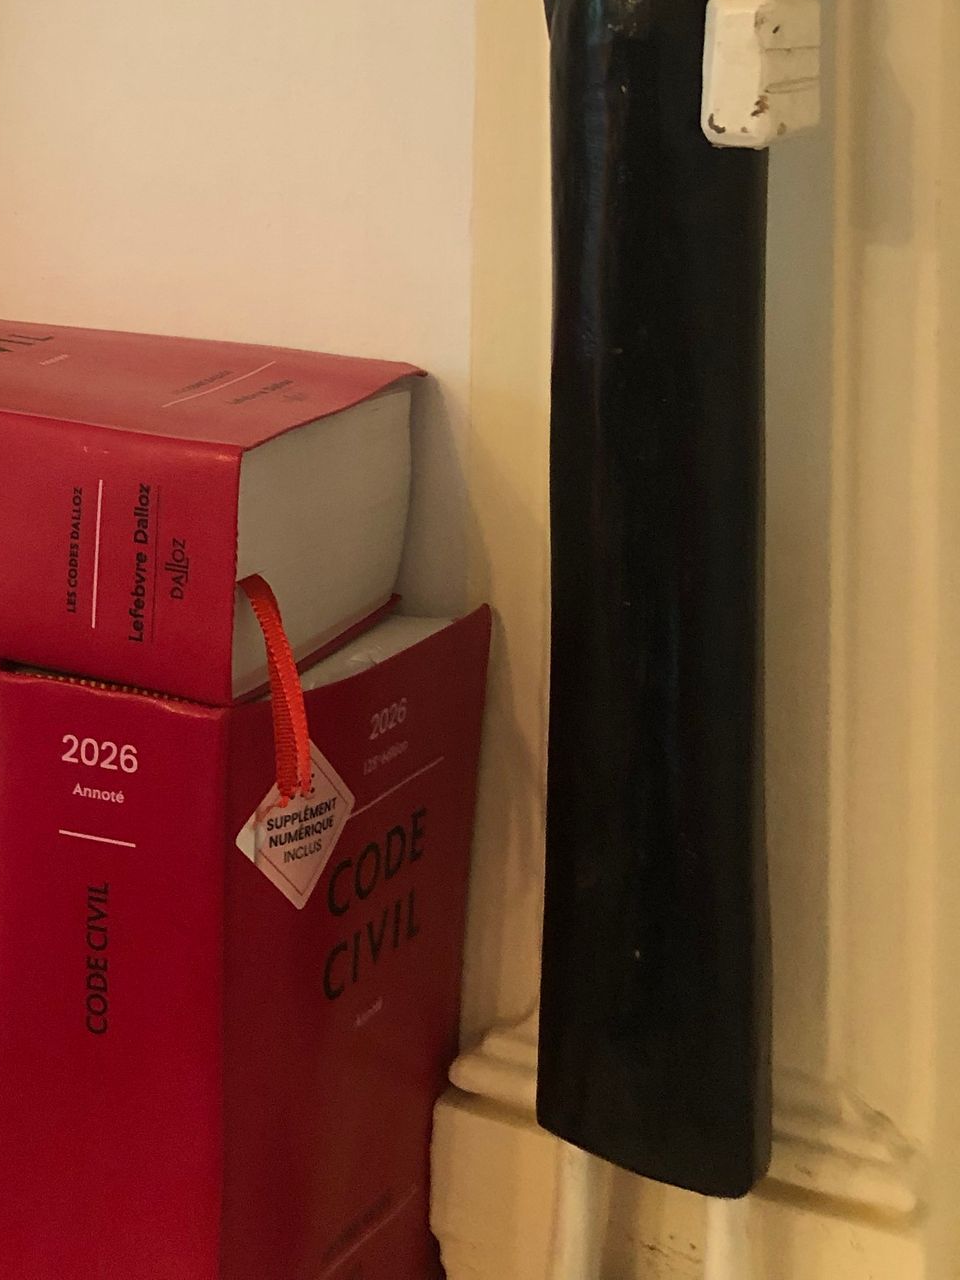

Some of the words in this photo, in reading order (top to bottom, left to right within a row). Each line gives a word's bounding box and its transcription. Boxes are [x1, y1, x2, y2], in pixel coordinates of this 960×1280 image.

[70, 487, 83, 541] DALLOZ
[133, 483, 151, 545] Dalloz
[67, 543, 79, 588] CODES
[164, 538, 190, 600] DALLOZ
[66, 591, 78, 614] LES
[128, 552, 148, 643] Lefebvre
[368, 697, 408, 741] 2026
[61, 734, 139, 774] 2026
[72, 782, 126, 804] Annoté
[266, 797, 338, 832] SUPPLÉMENT
[268, 815, 335, 849] NUMÉRIQUE
[282, 839, 322, 864] INCLUS
[327, 805, 428, 917] CODE
[86, 880, 110, 952] CIVIL
[323, 888, 420, 1001] CIVIL
[85, 955, 110, 1036] CODE
